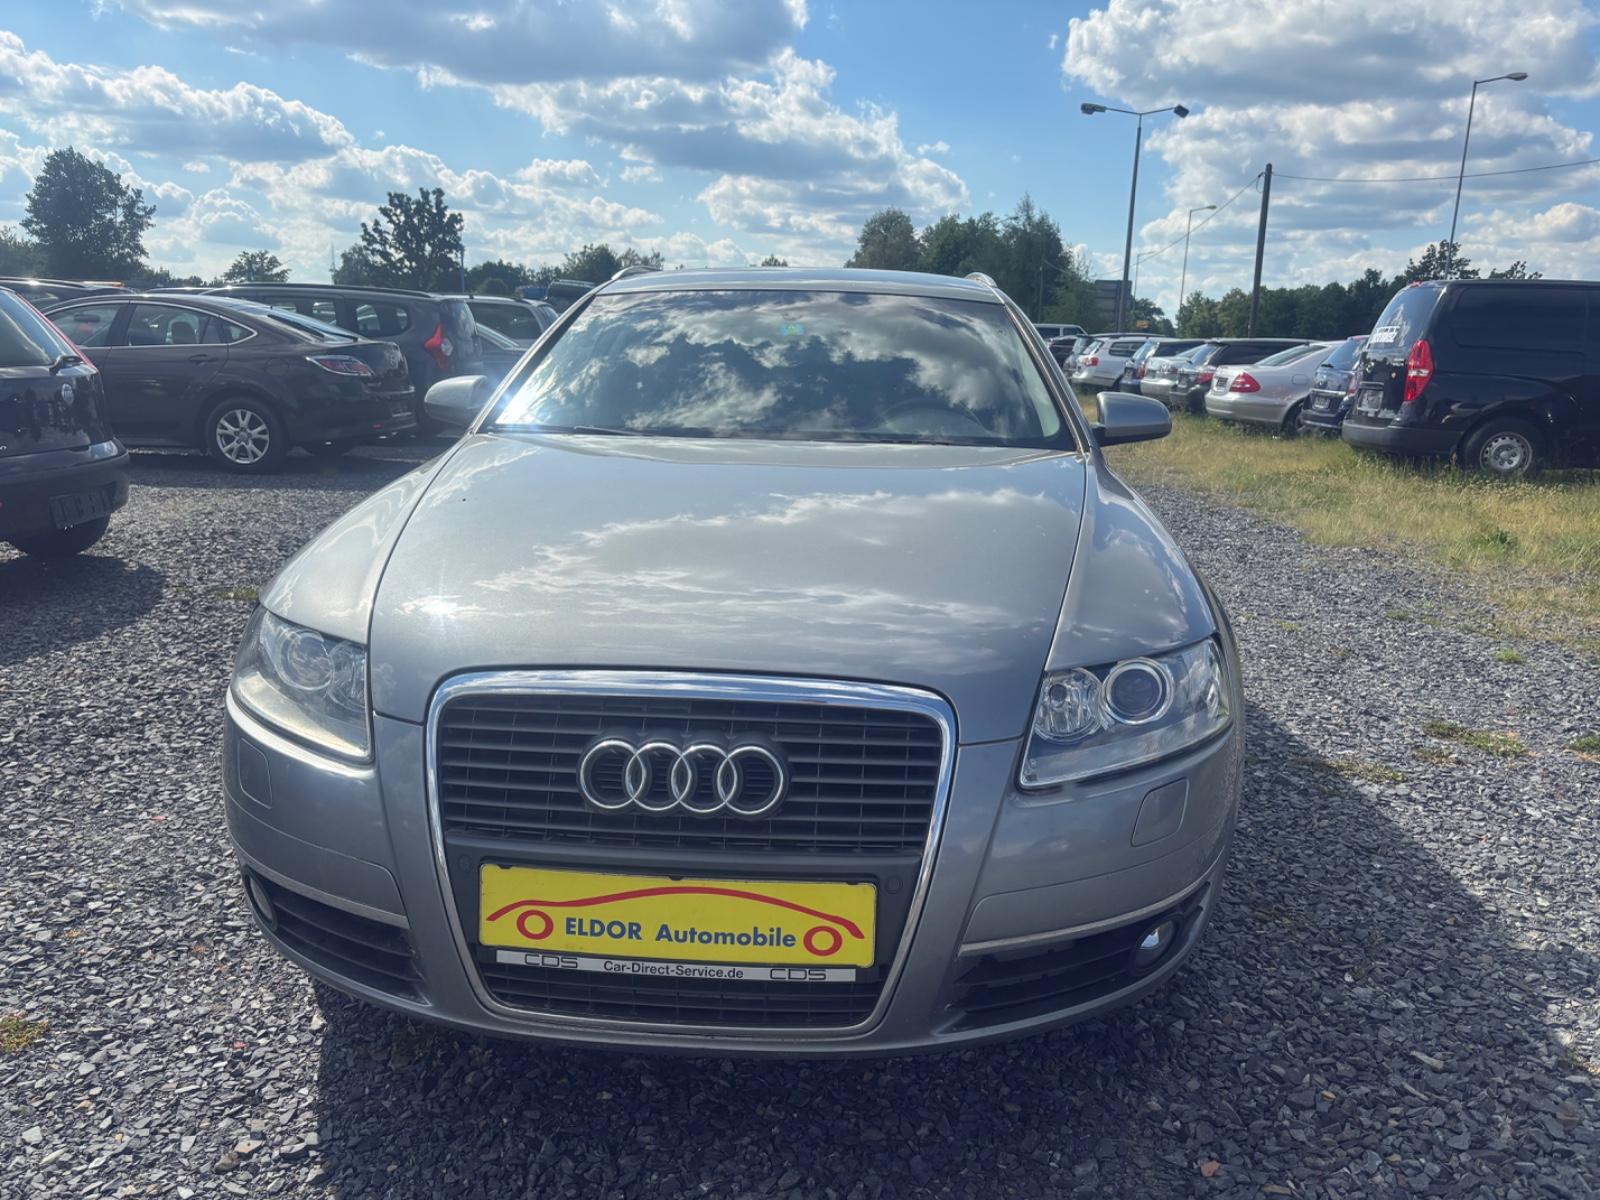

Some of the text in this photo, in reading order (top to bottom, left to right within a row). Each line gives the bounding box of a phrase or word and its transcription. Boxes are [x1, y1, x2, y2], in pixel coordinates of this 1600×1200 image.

[565, 917, 797, 948] ELDOR Automobile
[524, 953, 827, 981] CDS Car-Direct-Service.de CDS
